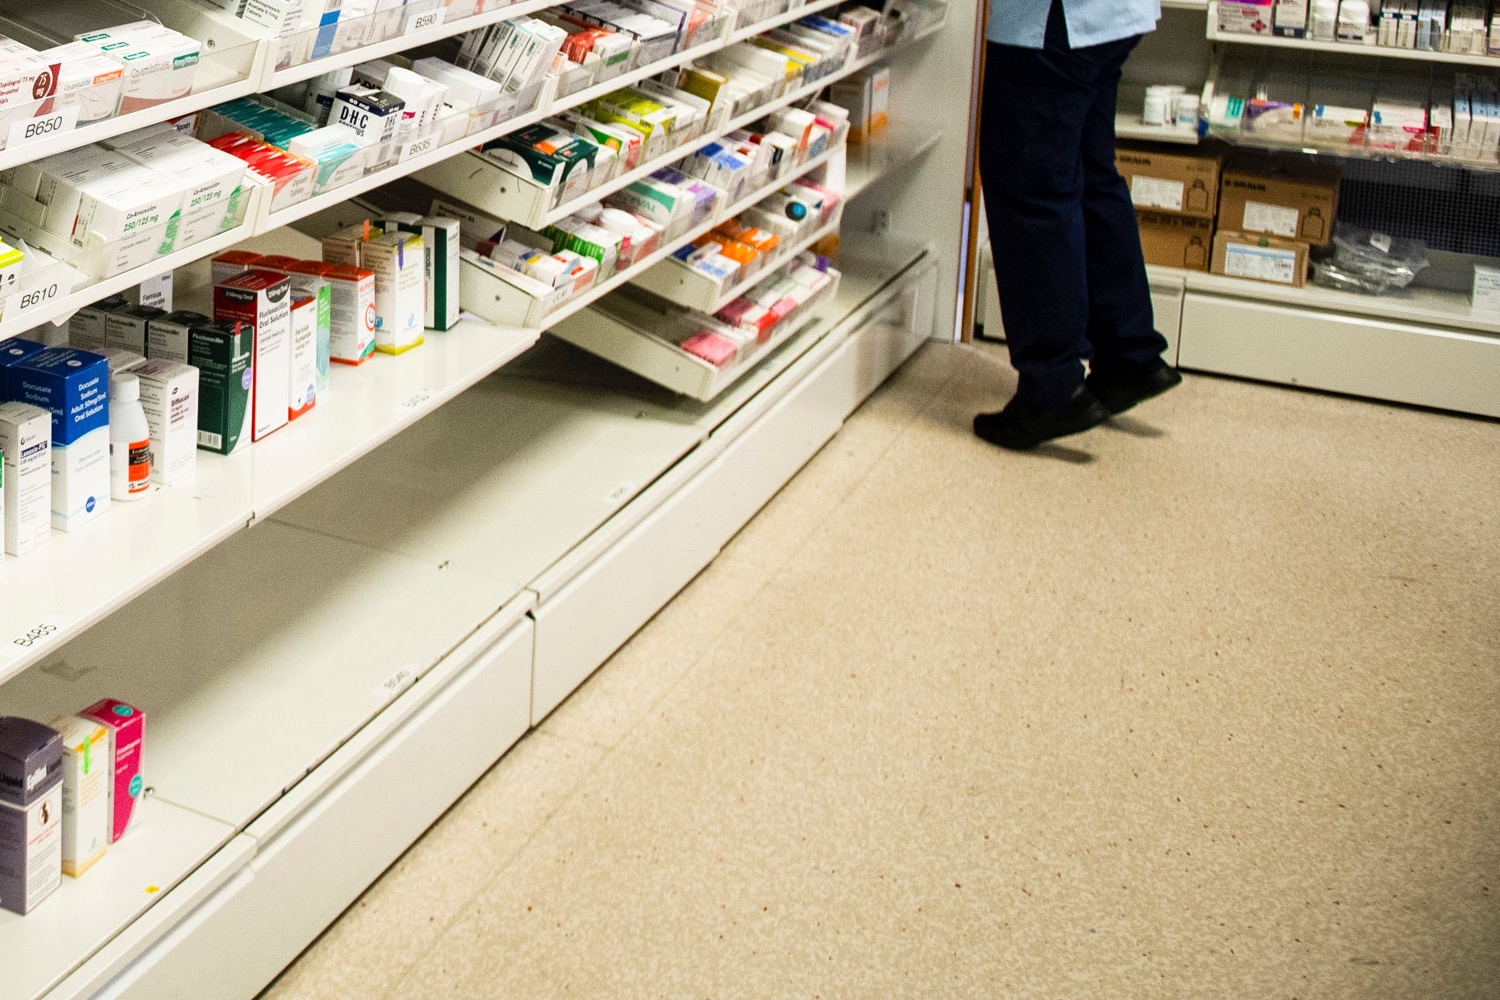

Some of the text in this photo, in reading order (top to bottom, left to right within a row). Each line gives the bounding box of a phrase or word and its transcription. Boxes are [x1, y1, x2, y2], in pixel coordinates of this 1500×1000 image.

[415, 13, 437, 29] B590
[25, 116, 63, 139] B650
[123, 213, 159, 232] 250/125 mg
[21, 284, 58, 309] B610
[78, 376, 100, 392] Docusate
[80, 386, 98, 400] Sodium
